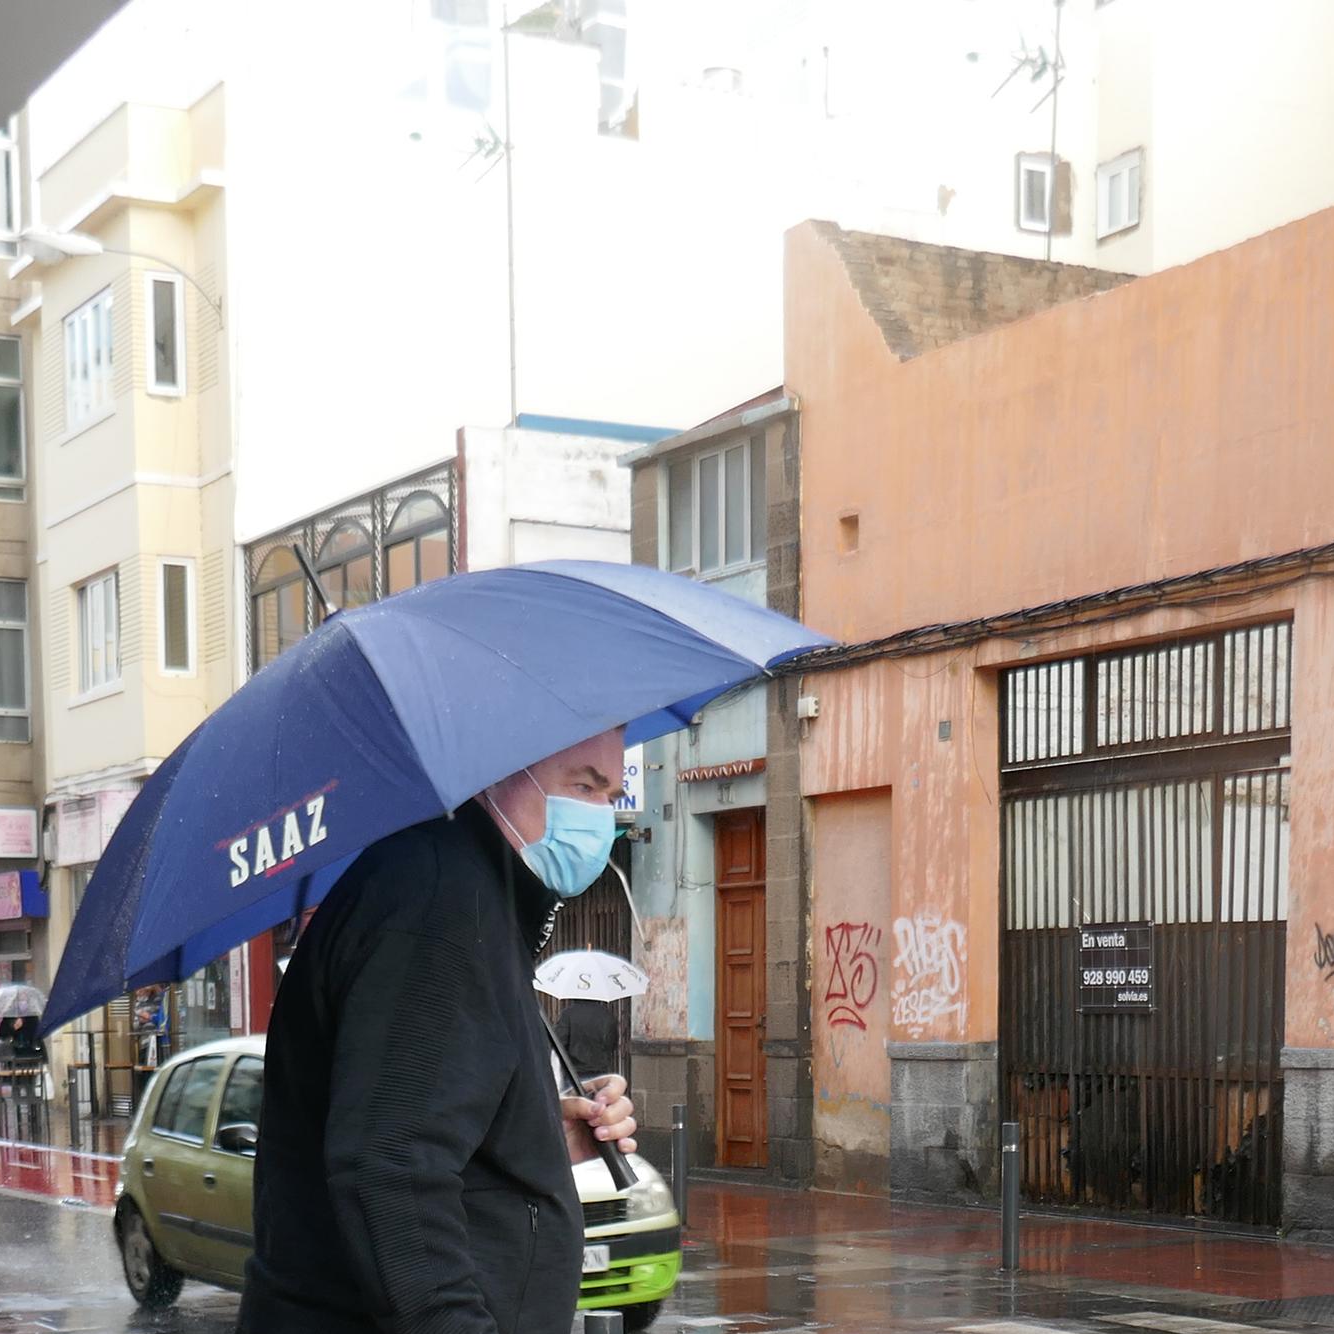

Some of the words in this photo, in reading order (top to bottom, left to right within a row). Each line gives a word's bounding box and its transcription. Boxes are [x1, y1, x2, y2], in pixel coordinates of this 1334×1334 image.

[229, 795, 328, 888] SAAZ
[1082, 933, 1095, 948] En
[1096, 932, 1125, 948] venta
[1083, 970, 1103, 985] 928
[1105, 970, 1126, 985] 990
[1128, 969, 1149, 985] 459
